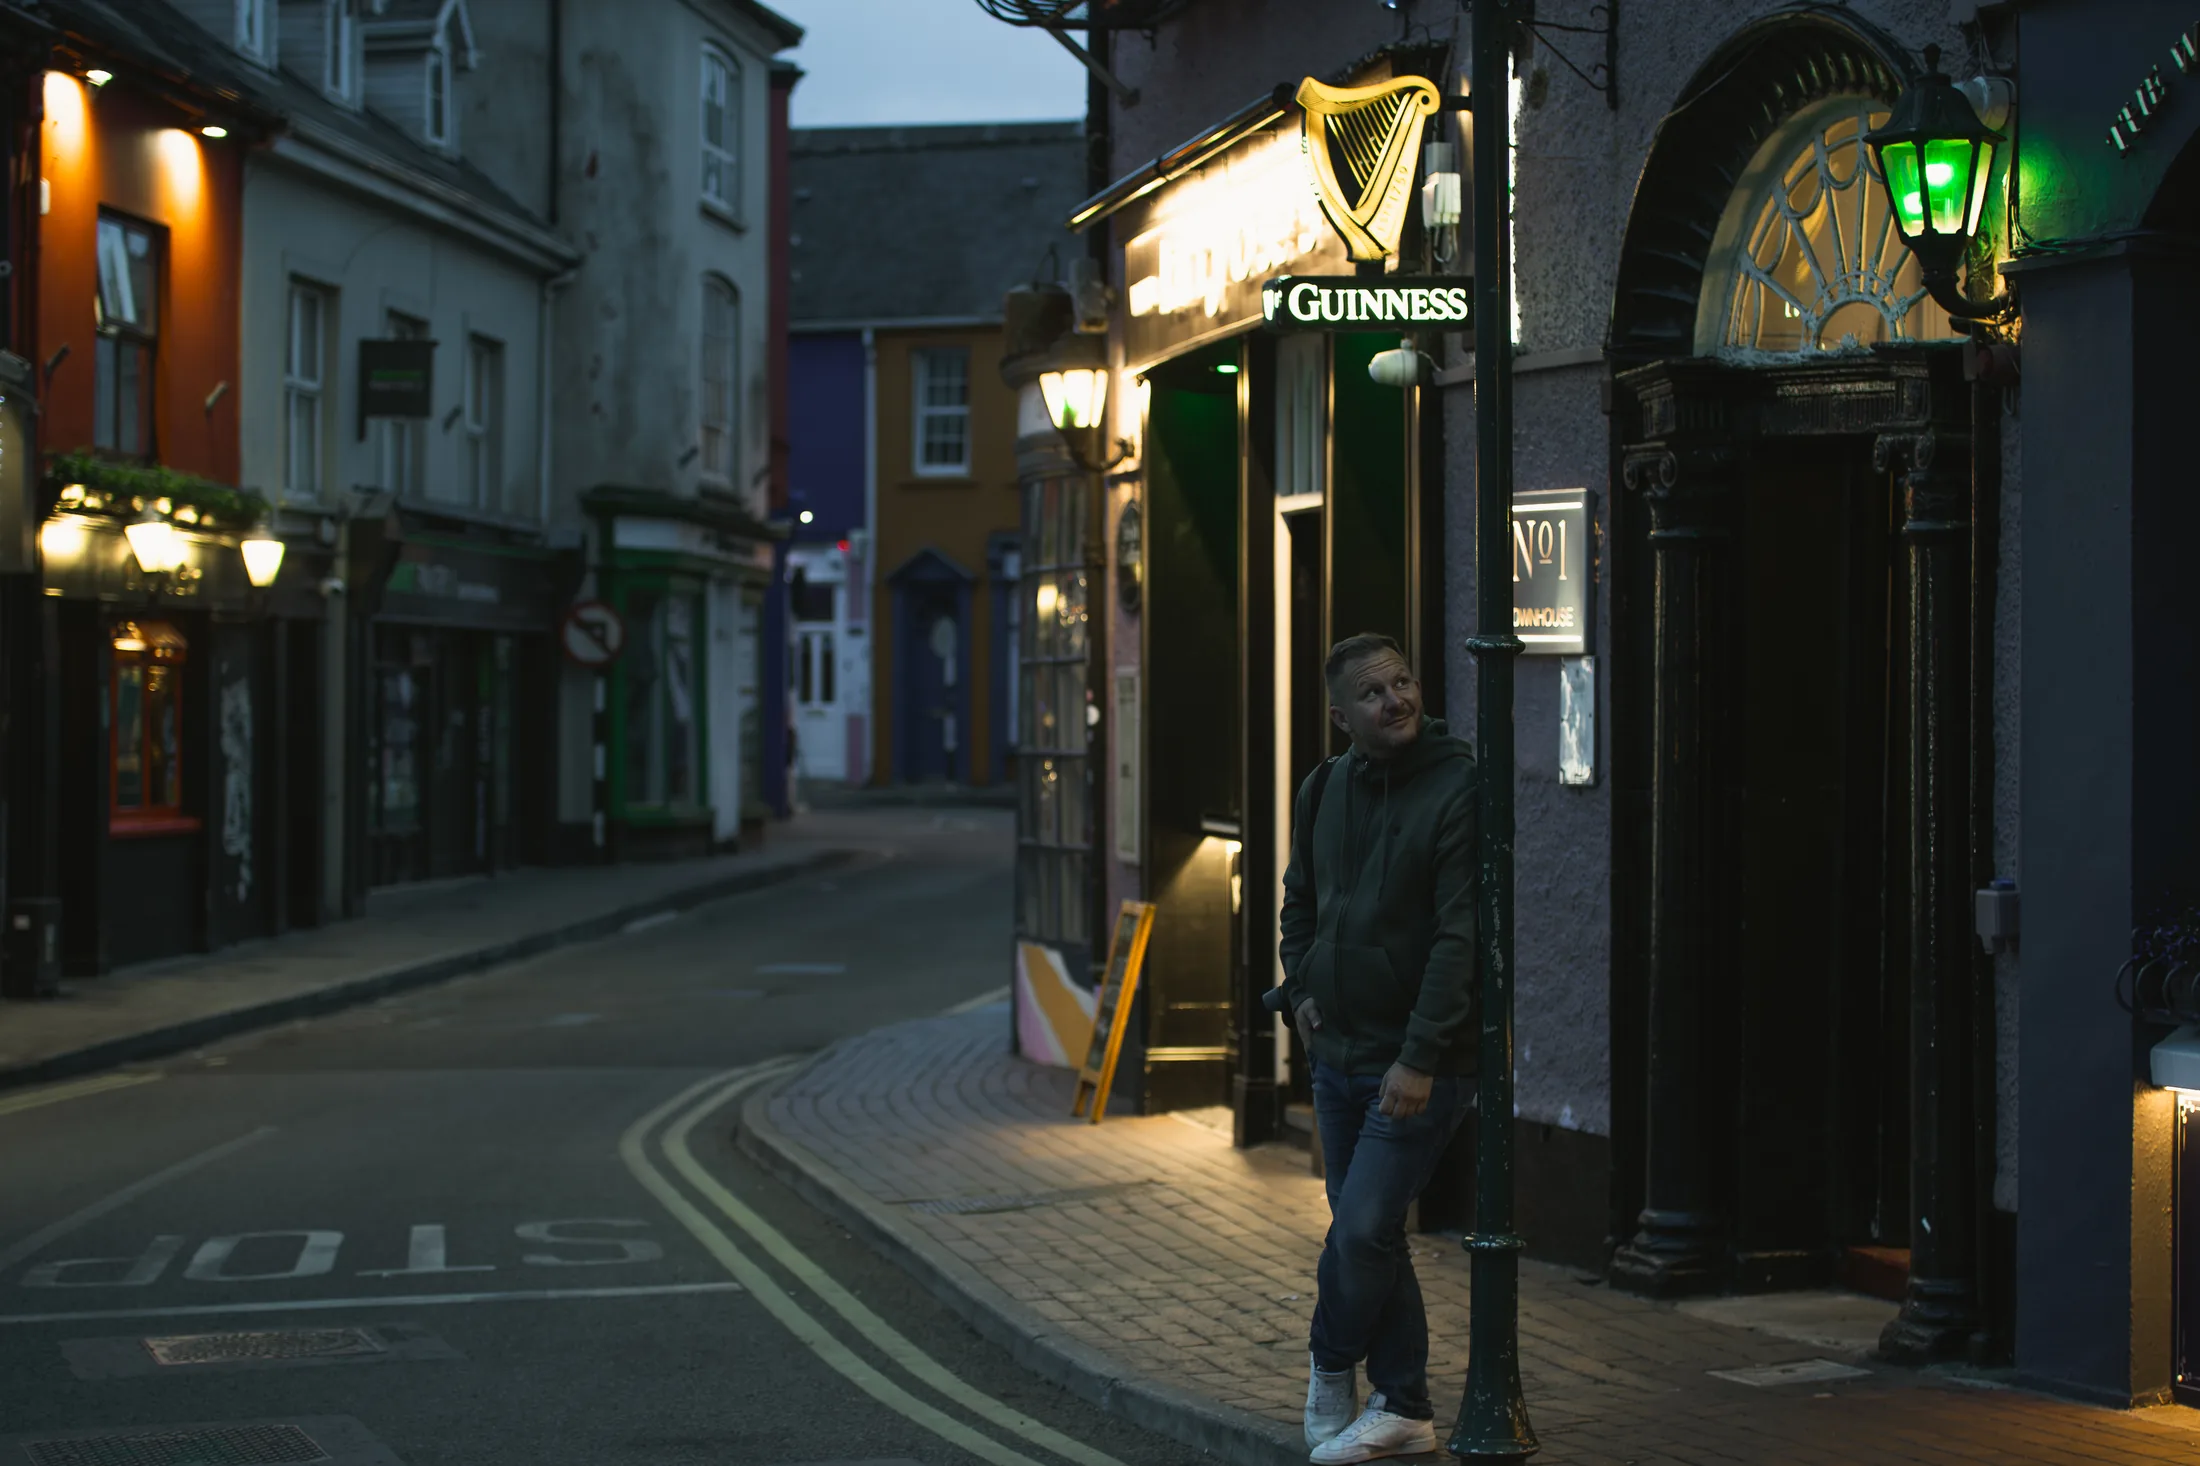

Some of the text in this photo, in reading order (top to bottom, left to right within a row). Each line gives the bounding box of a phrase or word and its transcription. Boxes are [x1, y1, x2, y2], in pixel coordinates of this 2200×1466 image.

[2105, 63, 2167, 154] THE
[1288, 283, 1468, 321] GUINNESS
[1512, 606, 1575, 628] OWNHOUSE
[18, 1218, 664, 1289] STOP
